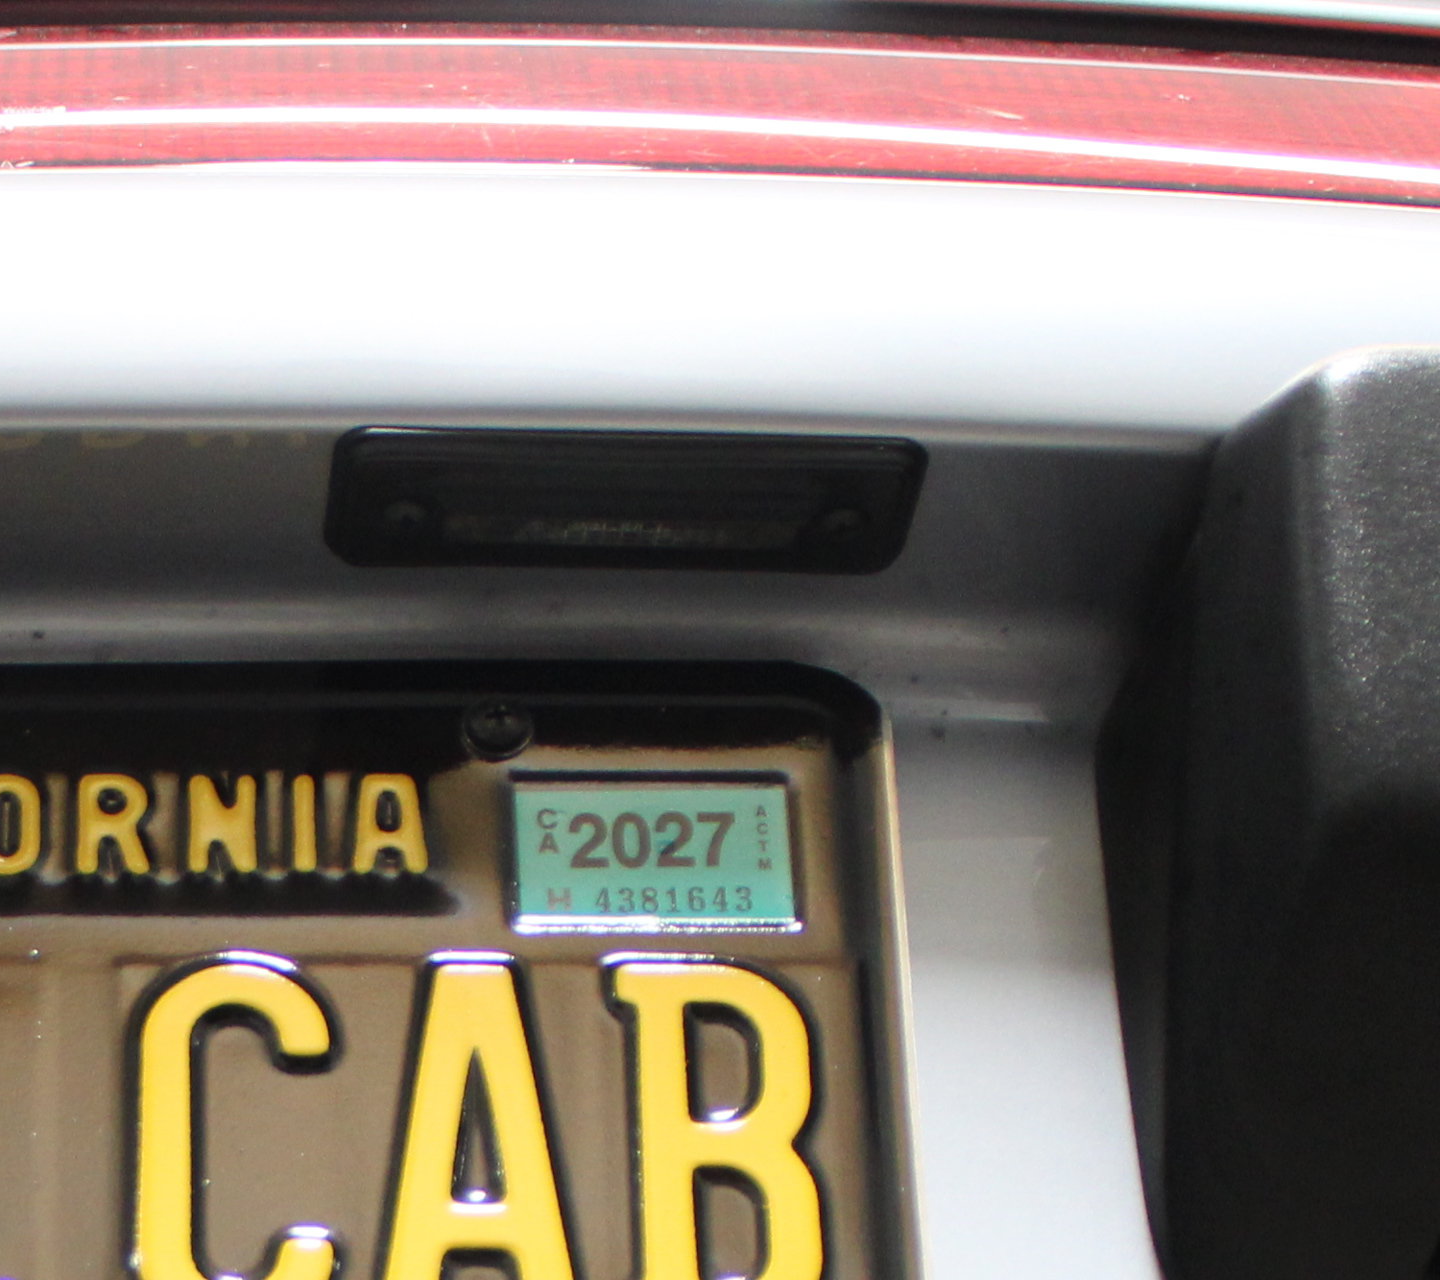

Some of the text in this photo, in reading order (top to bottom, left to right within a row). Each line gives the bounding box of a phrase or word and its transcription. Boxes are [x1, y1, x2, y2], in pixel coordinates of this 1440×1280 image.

[536, 808, 560, 854] CA
[568, 812, 735, 869] 2027
[595, 886, 753, 913] 4381643
